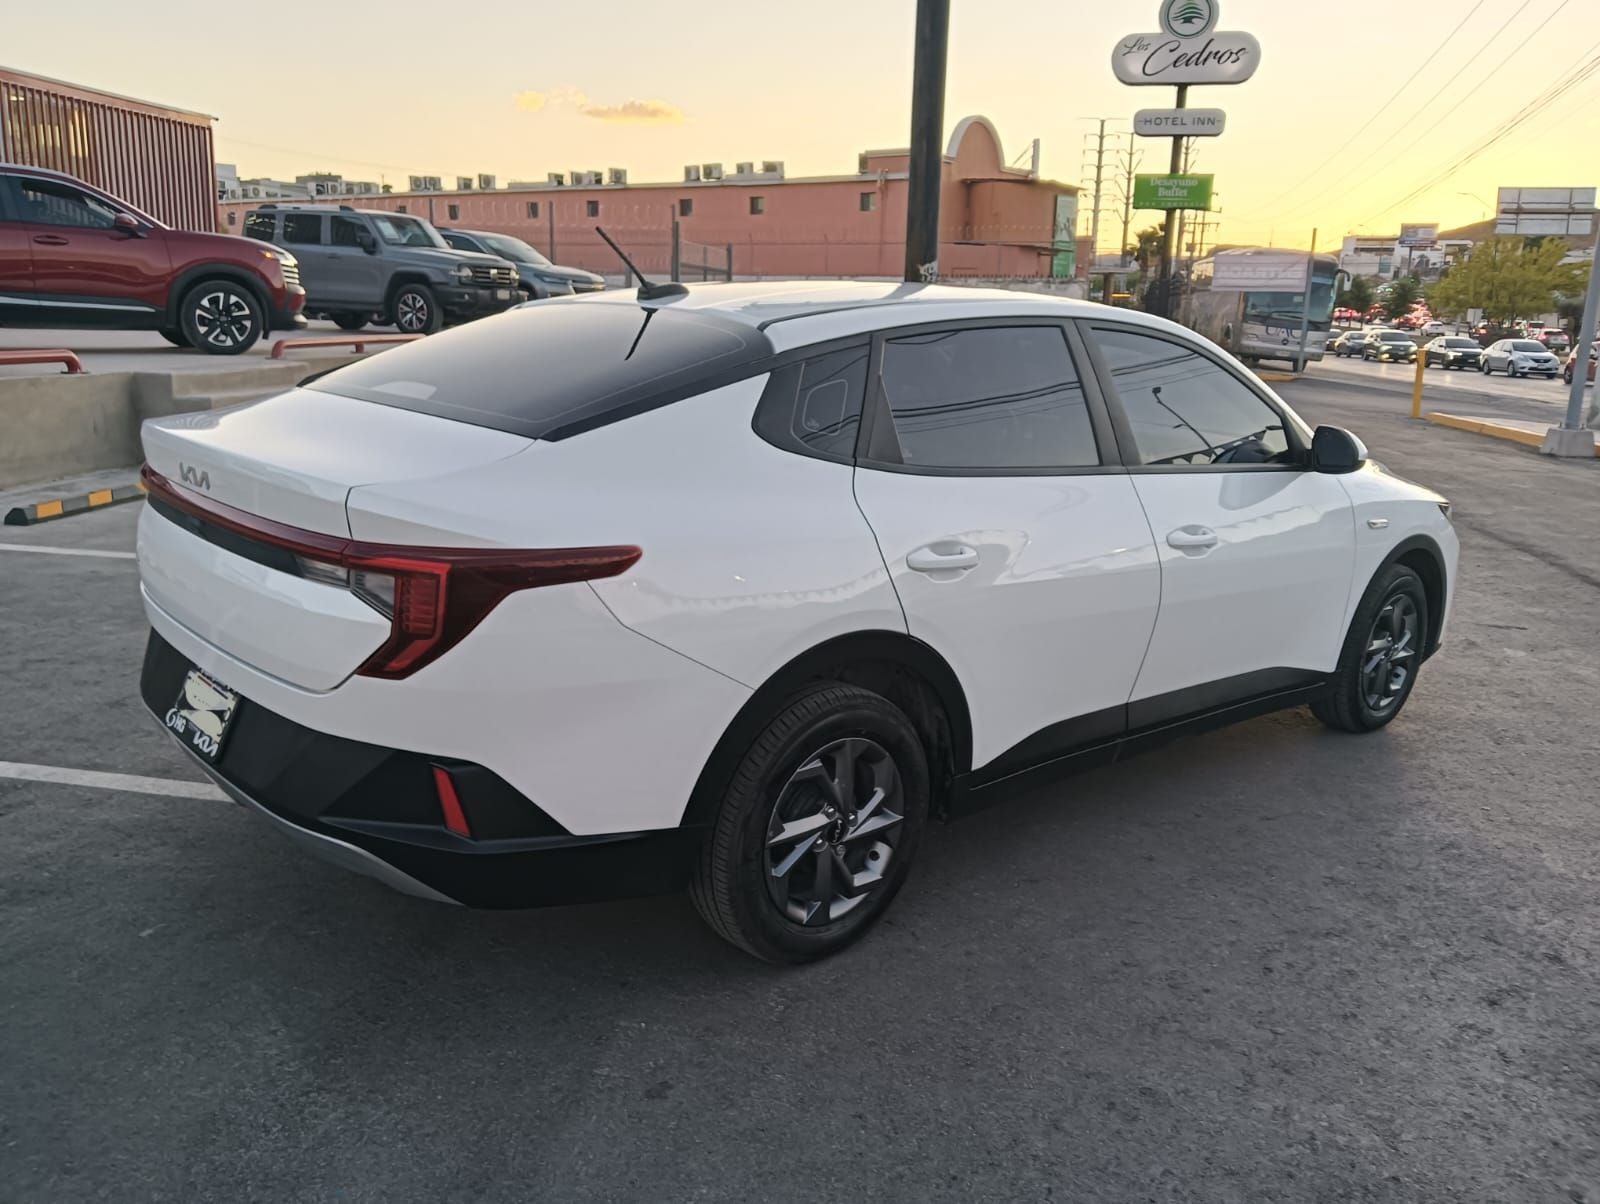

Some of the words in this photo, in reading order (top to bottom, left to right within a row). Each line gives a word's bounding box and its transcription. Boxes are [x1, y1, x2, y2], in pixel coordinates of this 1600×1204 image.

[1122, 37, 1151, 56] Los
[1142, 38, 1247, 76] Cedros
[1143, 116, 1187, 126] HOTEL
[1192, 115, 1216, 126] INN
[179, 461, 211, 491] KIA
